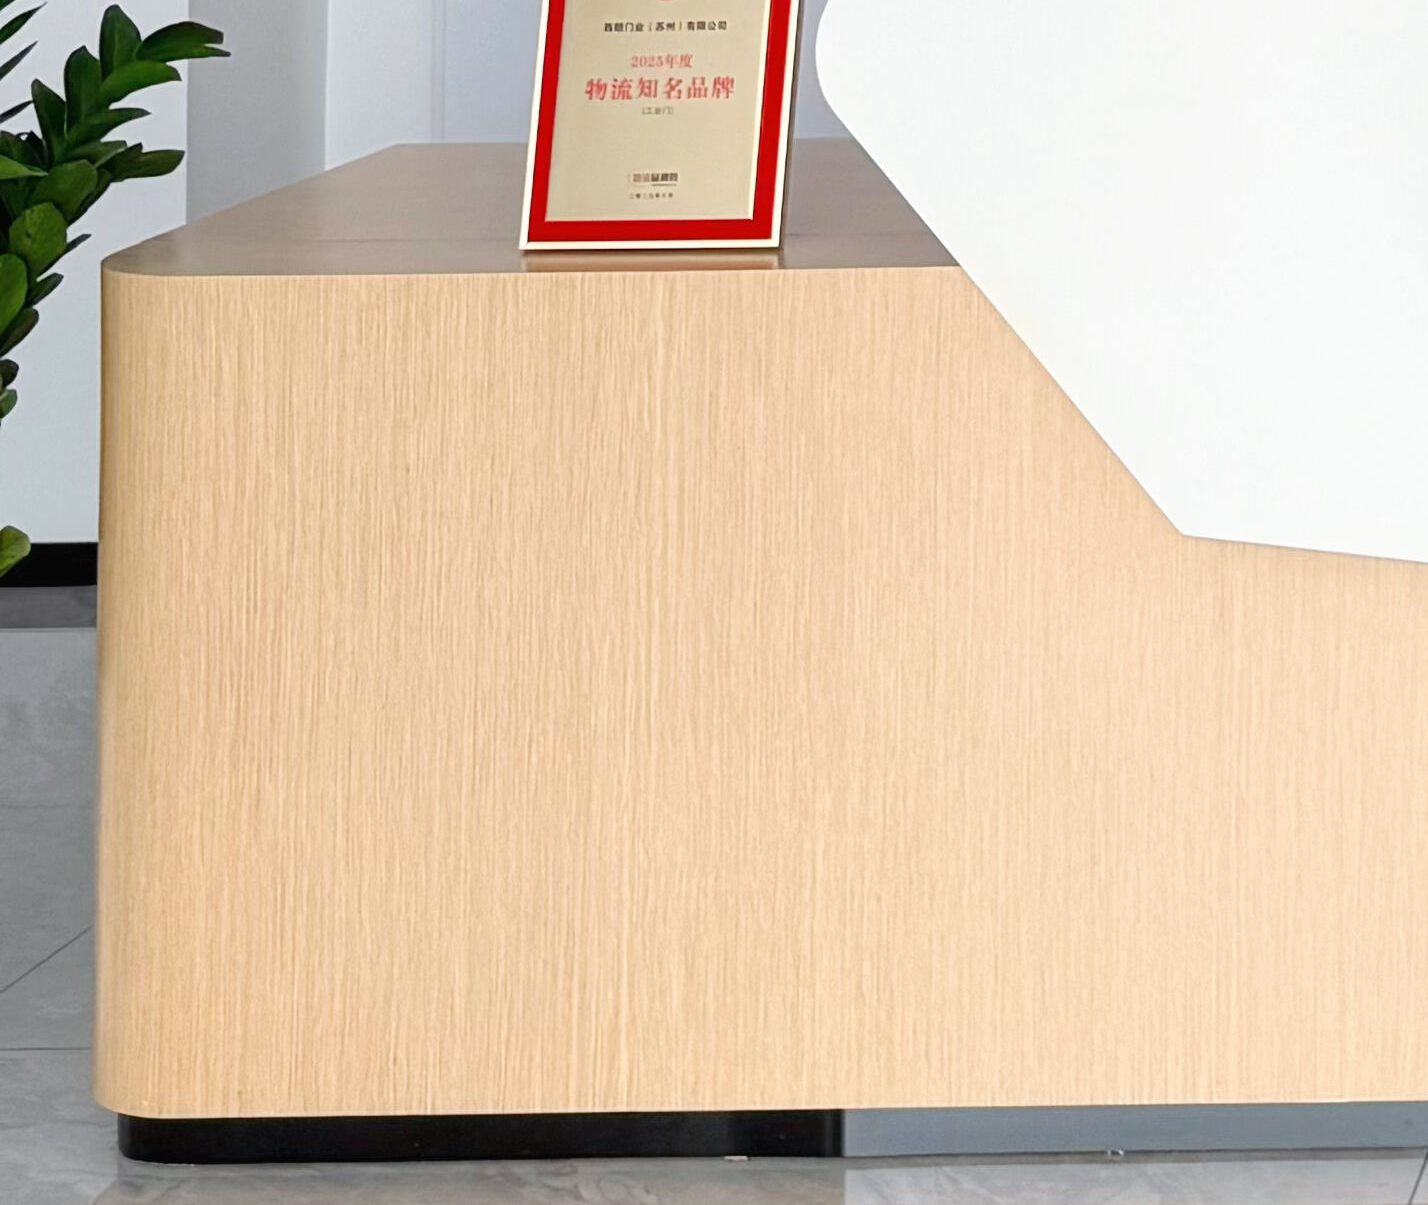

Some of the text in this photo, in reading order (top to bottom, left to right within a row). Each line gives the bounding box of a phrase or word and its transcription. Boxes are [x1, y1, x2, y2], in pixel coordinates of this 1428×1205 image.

[585, 76, 735, 101] 物流知名品牌
